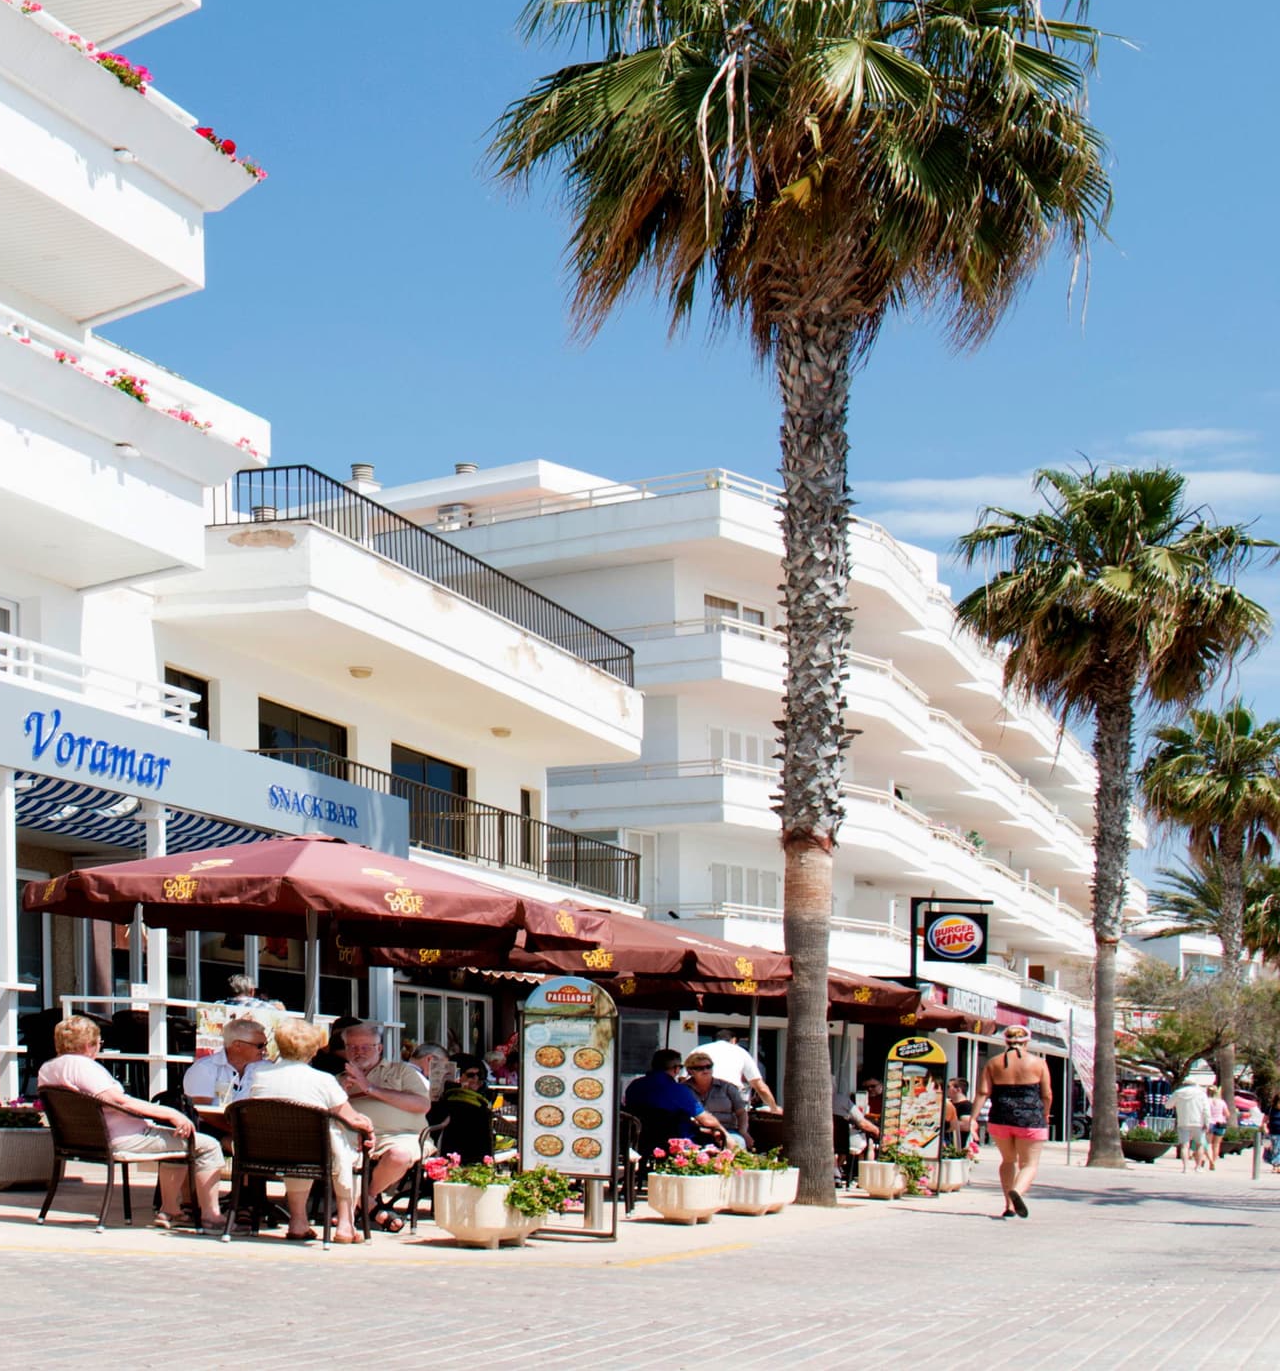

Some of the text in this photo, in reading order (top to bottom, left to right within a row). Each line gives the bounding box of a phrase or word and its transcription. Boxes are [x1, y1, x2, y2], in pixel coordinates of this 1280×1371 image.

[24, 709, 171, 788] Voramar
[269, 784, 359, 829] SNACK BAR
[163, 879, 199, 891] CARTE
[384, 891, 425, 905] CARTE
[934, 924, 974, 937] BURGER
[936, 931, 975, 948] KING
